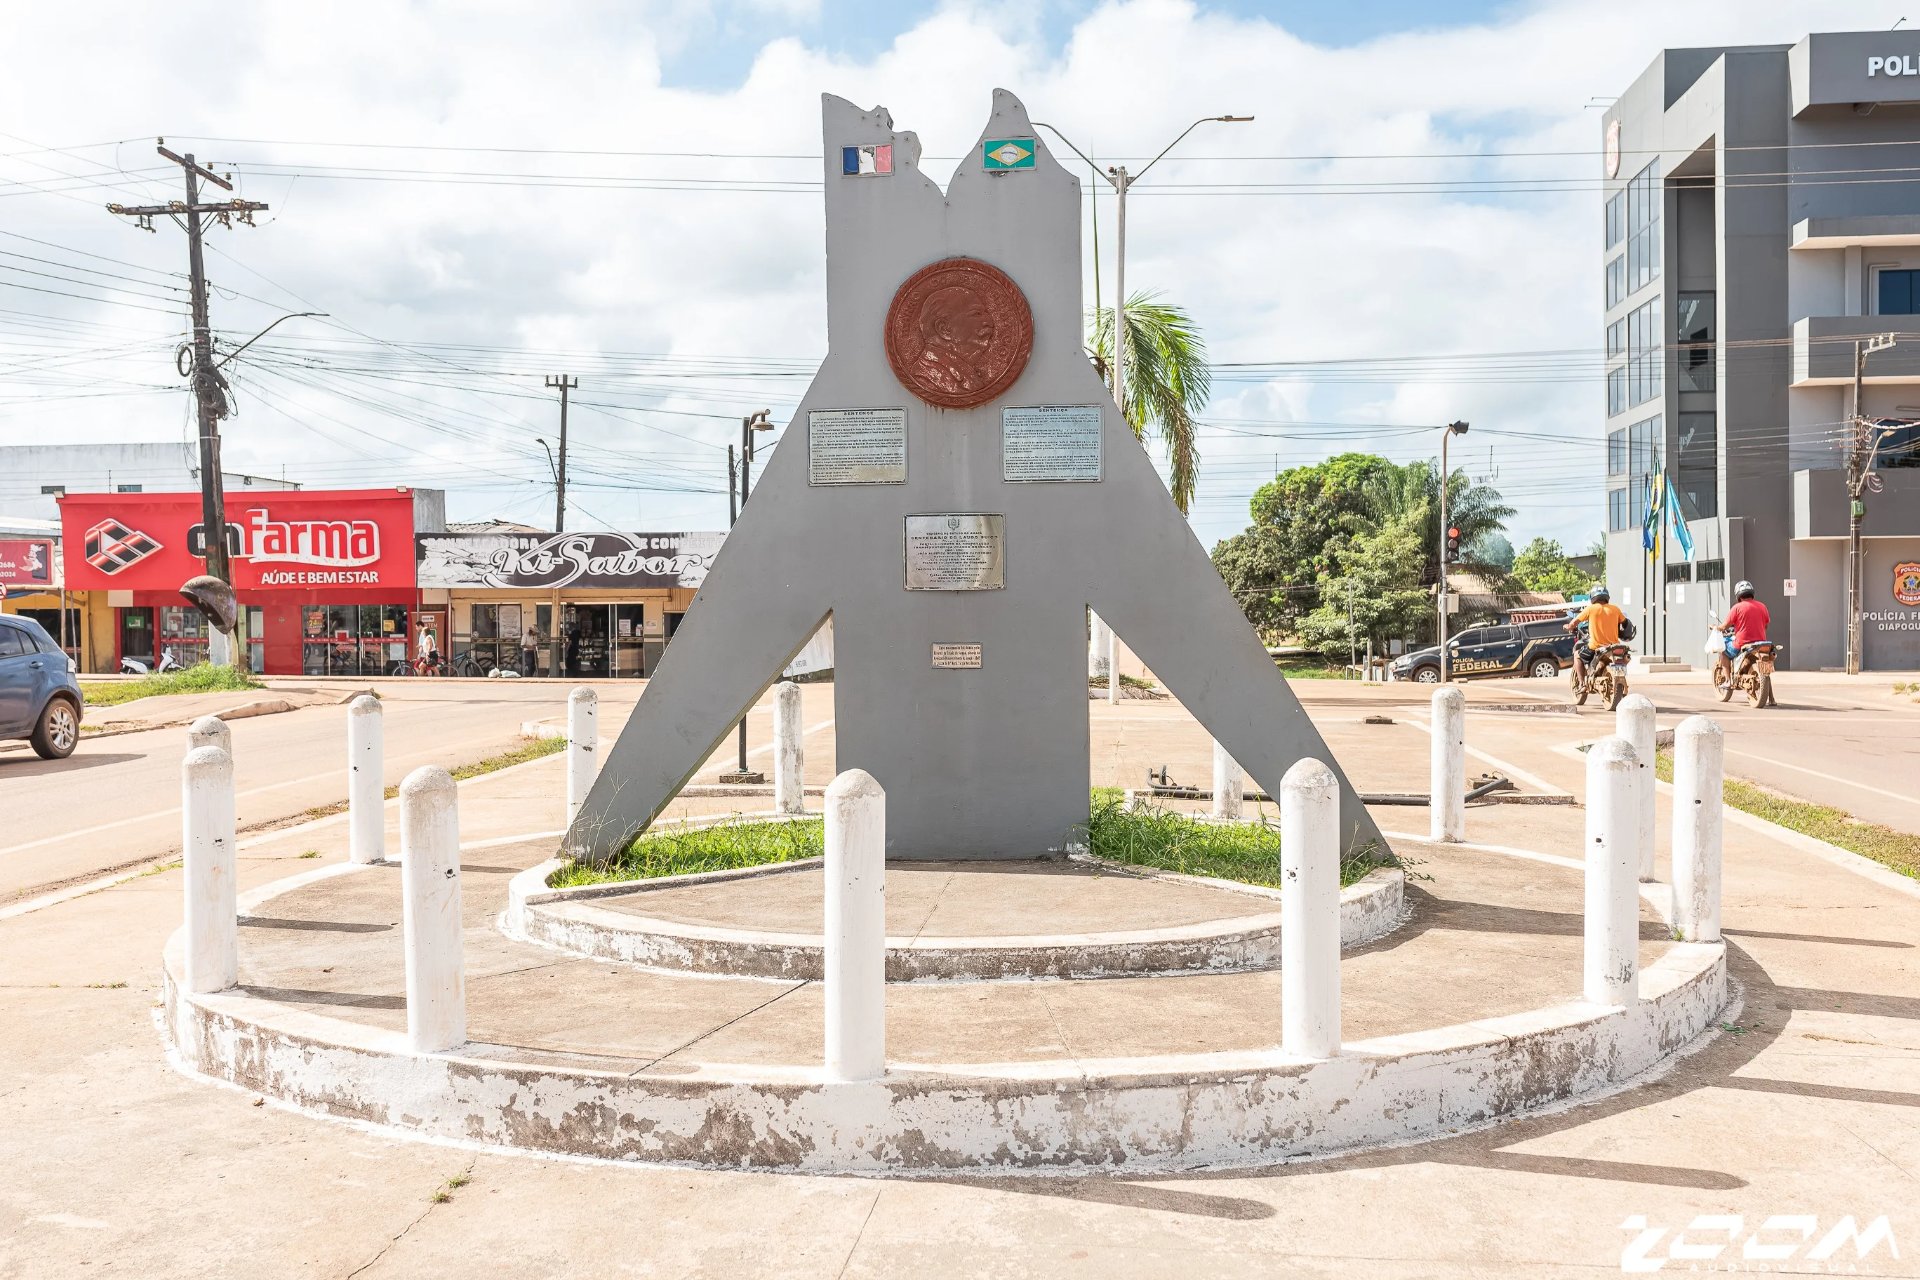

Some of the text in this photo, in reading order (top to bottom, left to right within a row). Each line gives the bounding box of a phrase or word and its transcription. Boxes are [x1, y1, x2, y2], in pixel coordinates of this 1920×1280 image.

[1868, 53, 1920, 77] POL
[298, 572, 306, 583] E
[307, 571, 337, 584] BEM
[338, 571, 379, 583] ESTAR
[1862, 609, 1906, 620] POLÍCIA
[1452, 660, 1503, 672] FEDERAL
